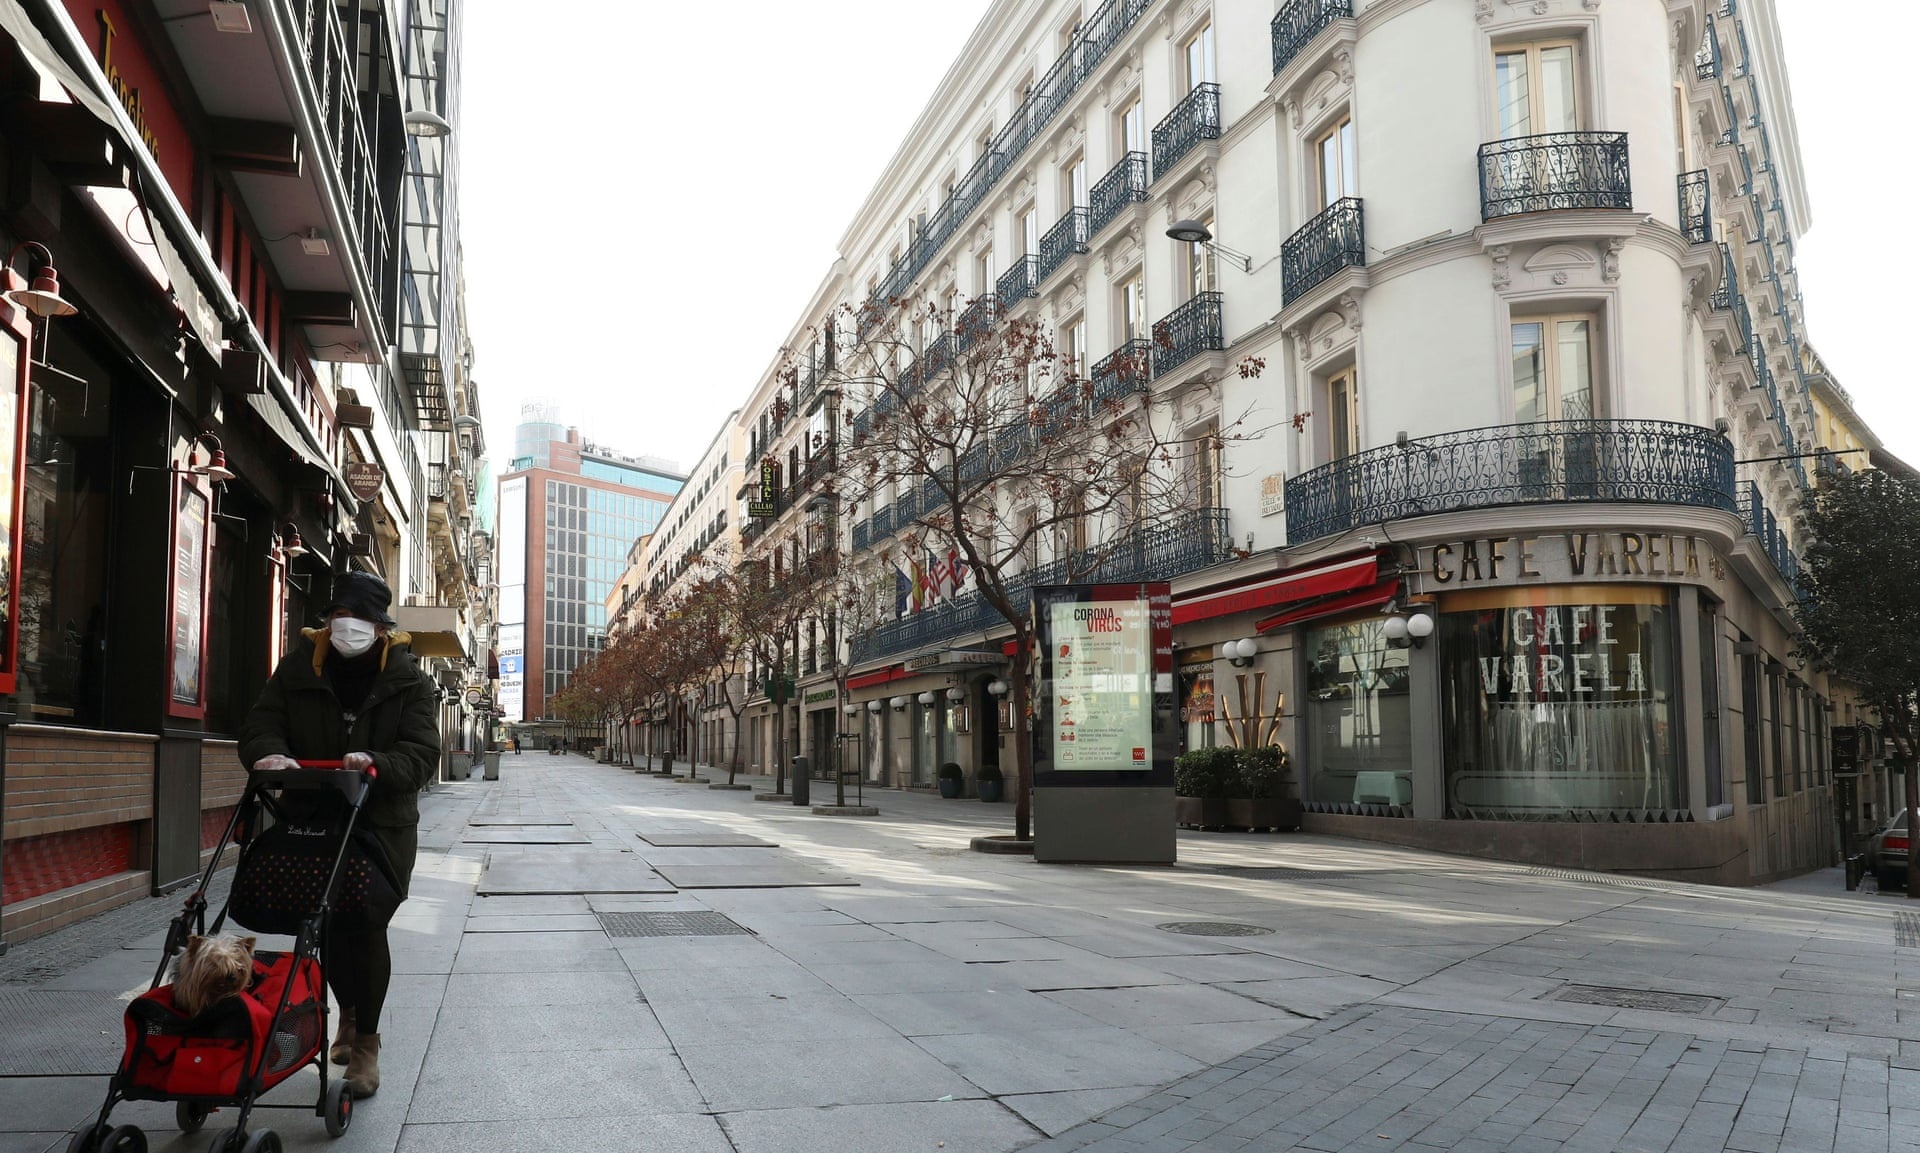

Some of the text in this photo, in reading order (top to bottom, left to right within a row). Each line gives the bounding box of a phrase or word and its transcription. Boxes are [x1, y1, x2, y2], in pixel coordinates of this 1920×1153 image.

[350, 473, 373, 481] ASADOR
[1432, 537, 1541, 583] CAFE
[1565, 532, 1701, 576] VARELA
[1074, 607, 1115, 621] CORONA
[1087, 617, 1122, 632] VIRUS
[1479, 606, 1648, 695] CAFE VARELA
